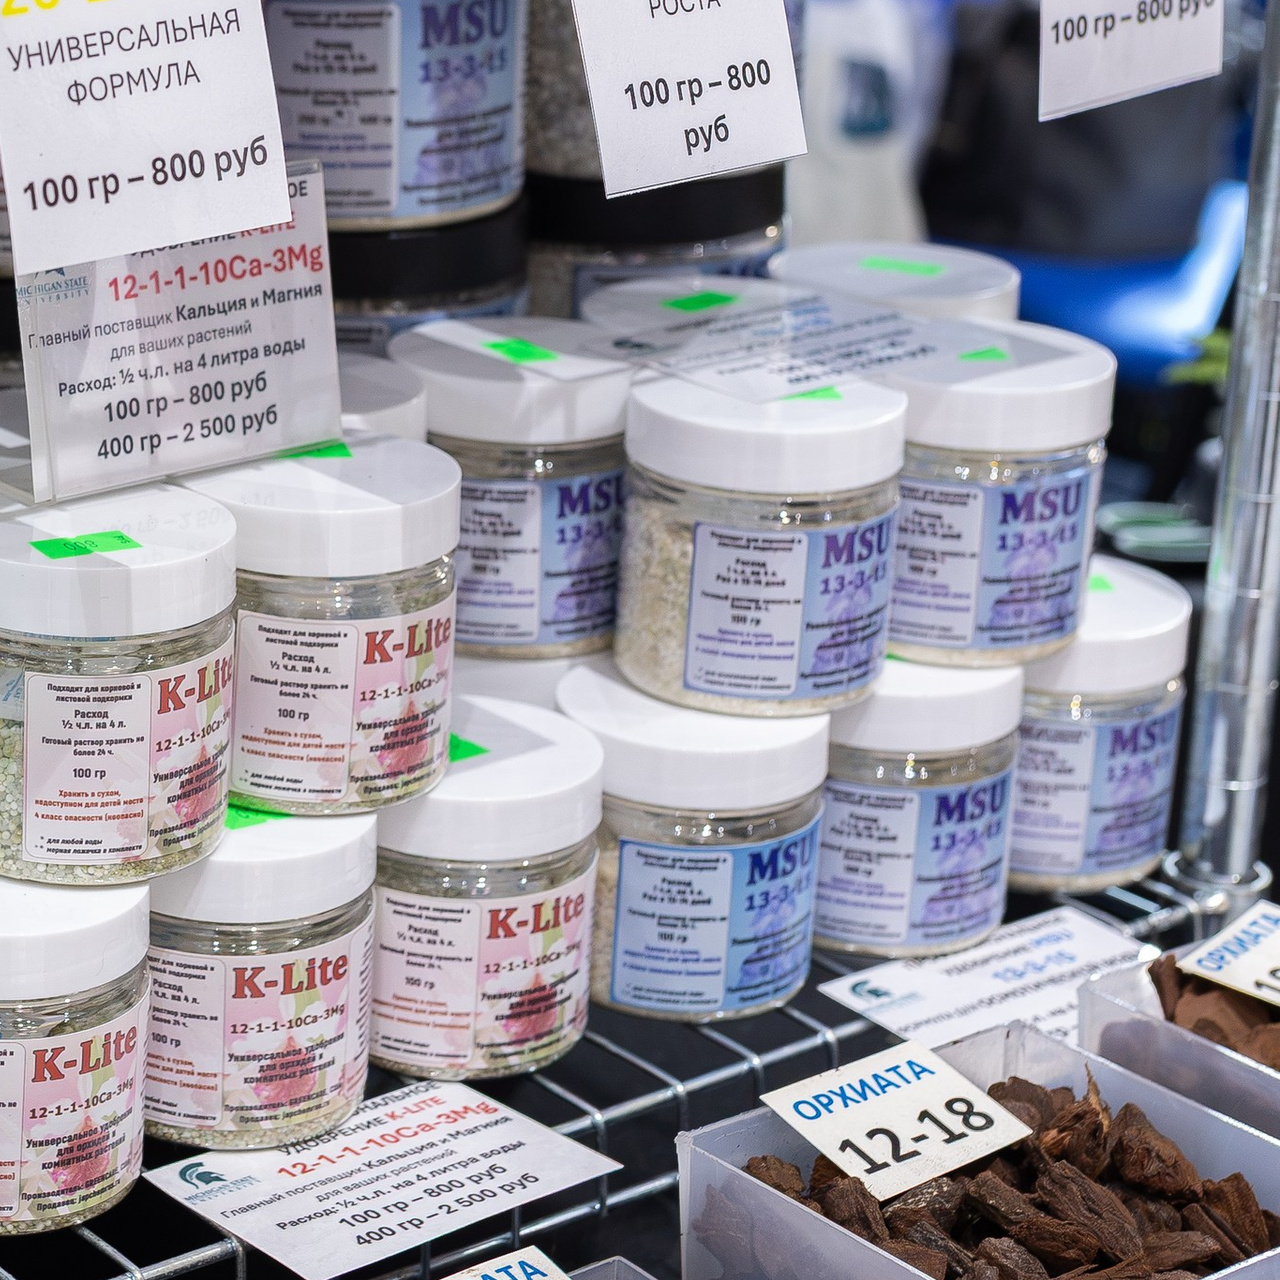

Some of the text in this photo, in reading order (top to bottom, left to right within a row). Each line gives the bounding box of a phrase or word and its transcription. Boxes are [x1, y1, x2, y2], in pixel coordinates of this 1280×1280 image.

[7, 9, 241, 72] УНИВЕРСАЛЬНАЯ
[1051, 14, 1087, 44] 100
[1094, 12, 1115, 38] гр
[67, 61, 200, 105] ФОРМУЛА
[624, 59, 771, 110] 100 гр 800
[684, 114, 729, 155] руб
[24, 136, 268, 211] 100 гр 800 руб
[109, 244, 324, 301] 12-1-1-10Ca-3Mg
[28, 284, 322, 349] Главный поставщик Кальция и Магния
[998, 483, 1083, 526] MSU
[232, 953, 348, 1000] K-Lite
[230, 1002, 345, 1036] 12-1-1-10Ca-3Mg
[31, 1023, 138, 1084] K-Lite
[29, 1076, 134, 1120] 12-1-1-10Ca-3Mg
[791, 1058, 936, 1121] ОРХИАТА
[838, 1096, 994, 1175] 12-18
[339, 1163, 508, 1229] 100 гр 800 руб
